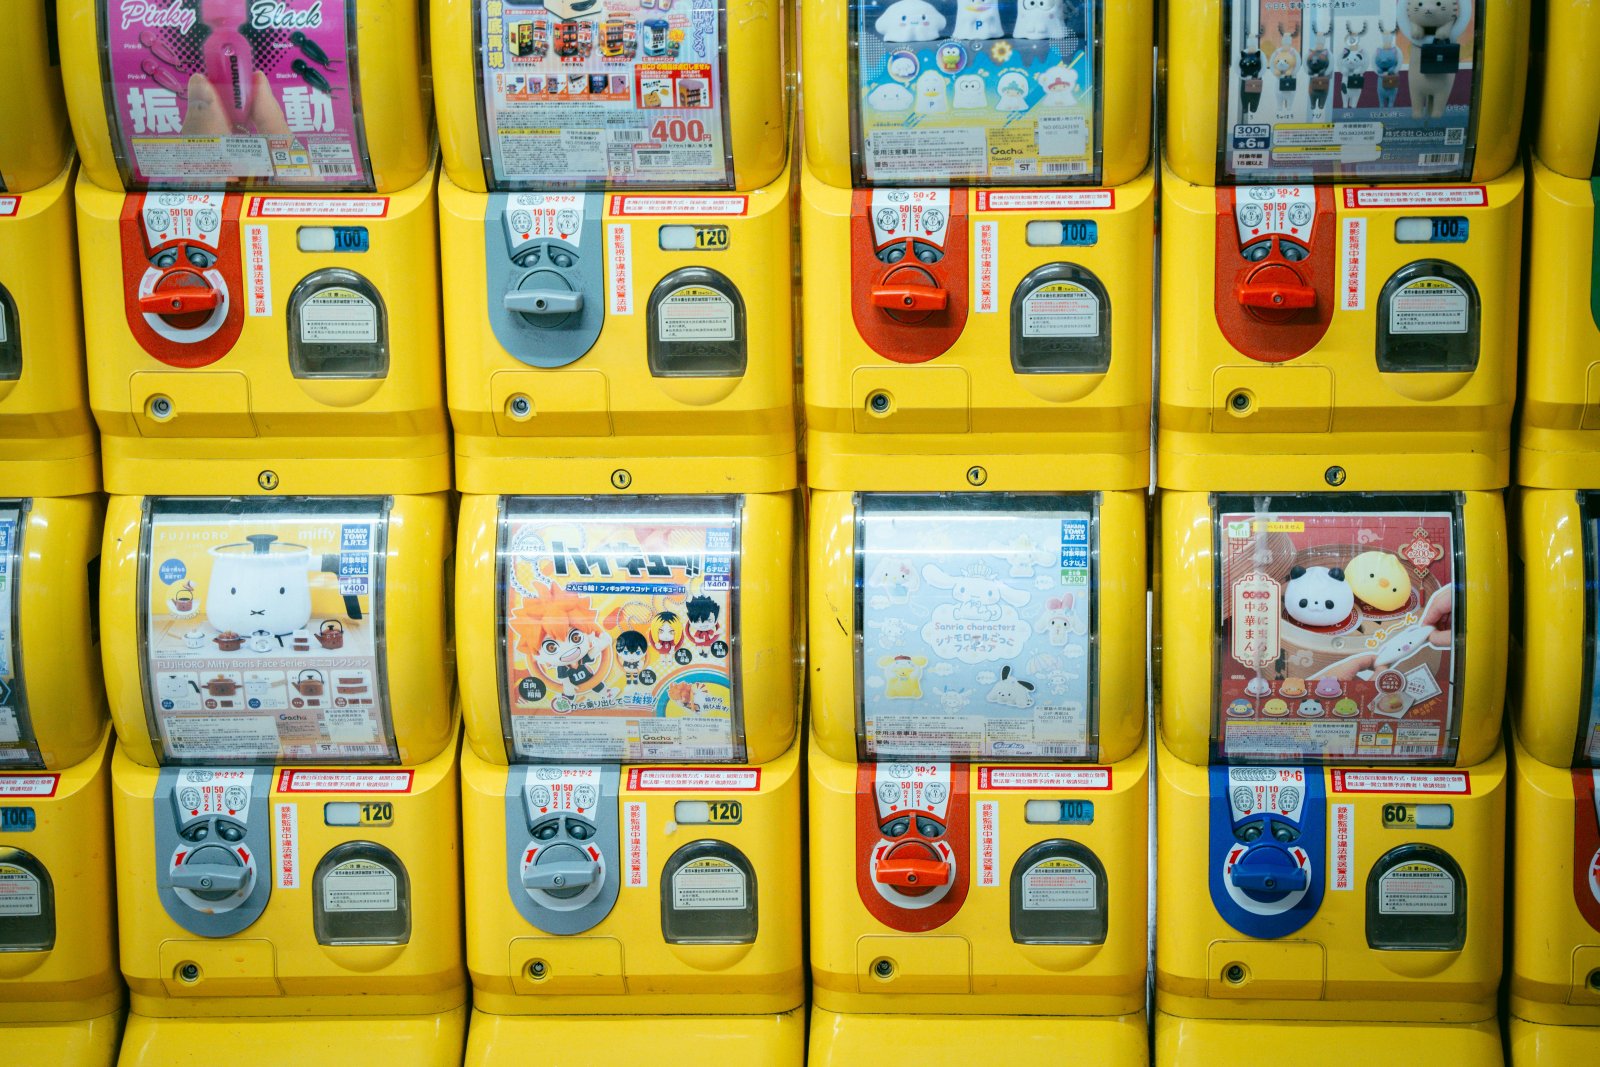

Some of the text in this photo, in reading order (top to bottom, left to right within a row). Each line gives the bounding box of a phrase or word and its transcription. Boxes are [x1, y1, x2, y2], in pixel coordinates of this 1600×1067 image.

[121, 0, 322, 35] Pinky Black
[976, 21, 982, 30] P
[127, 86, 336, 133] 振 動
[652, 120, 712, 142] 400円
[1238, 126, 1267, 134] 300円
[990, 147, 1023, 155] Gacha
[1238, 138, 1265, 148] 全6種
[697, 228, 727, 246] 120
[160, 528, 336, 544] FUJIHORO miffy
[966, 623, 1016, 631] characters
[1244, 602, 1255, 652] 中華まん
[157, 659, 368, 670] FUJIHORO Miffy Boris Face Series ミニコレクション
[573, 671, 586, 681] 10
[362, 804, 392, 821] 120
[710, 803, 740, 820] 120
[1384, 805, 1414, 823] 60元
